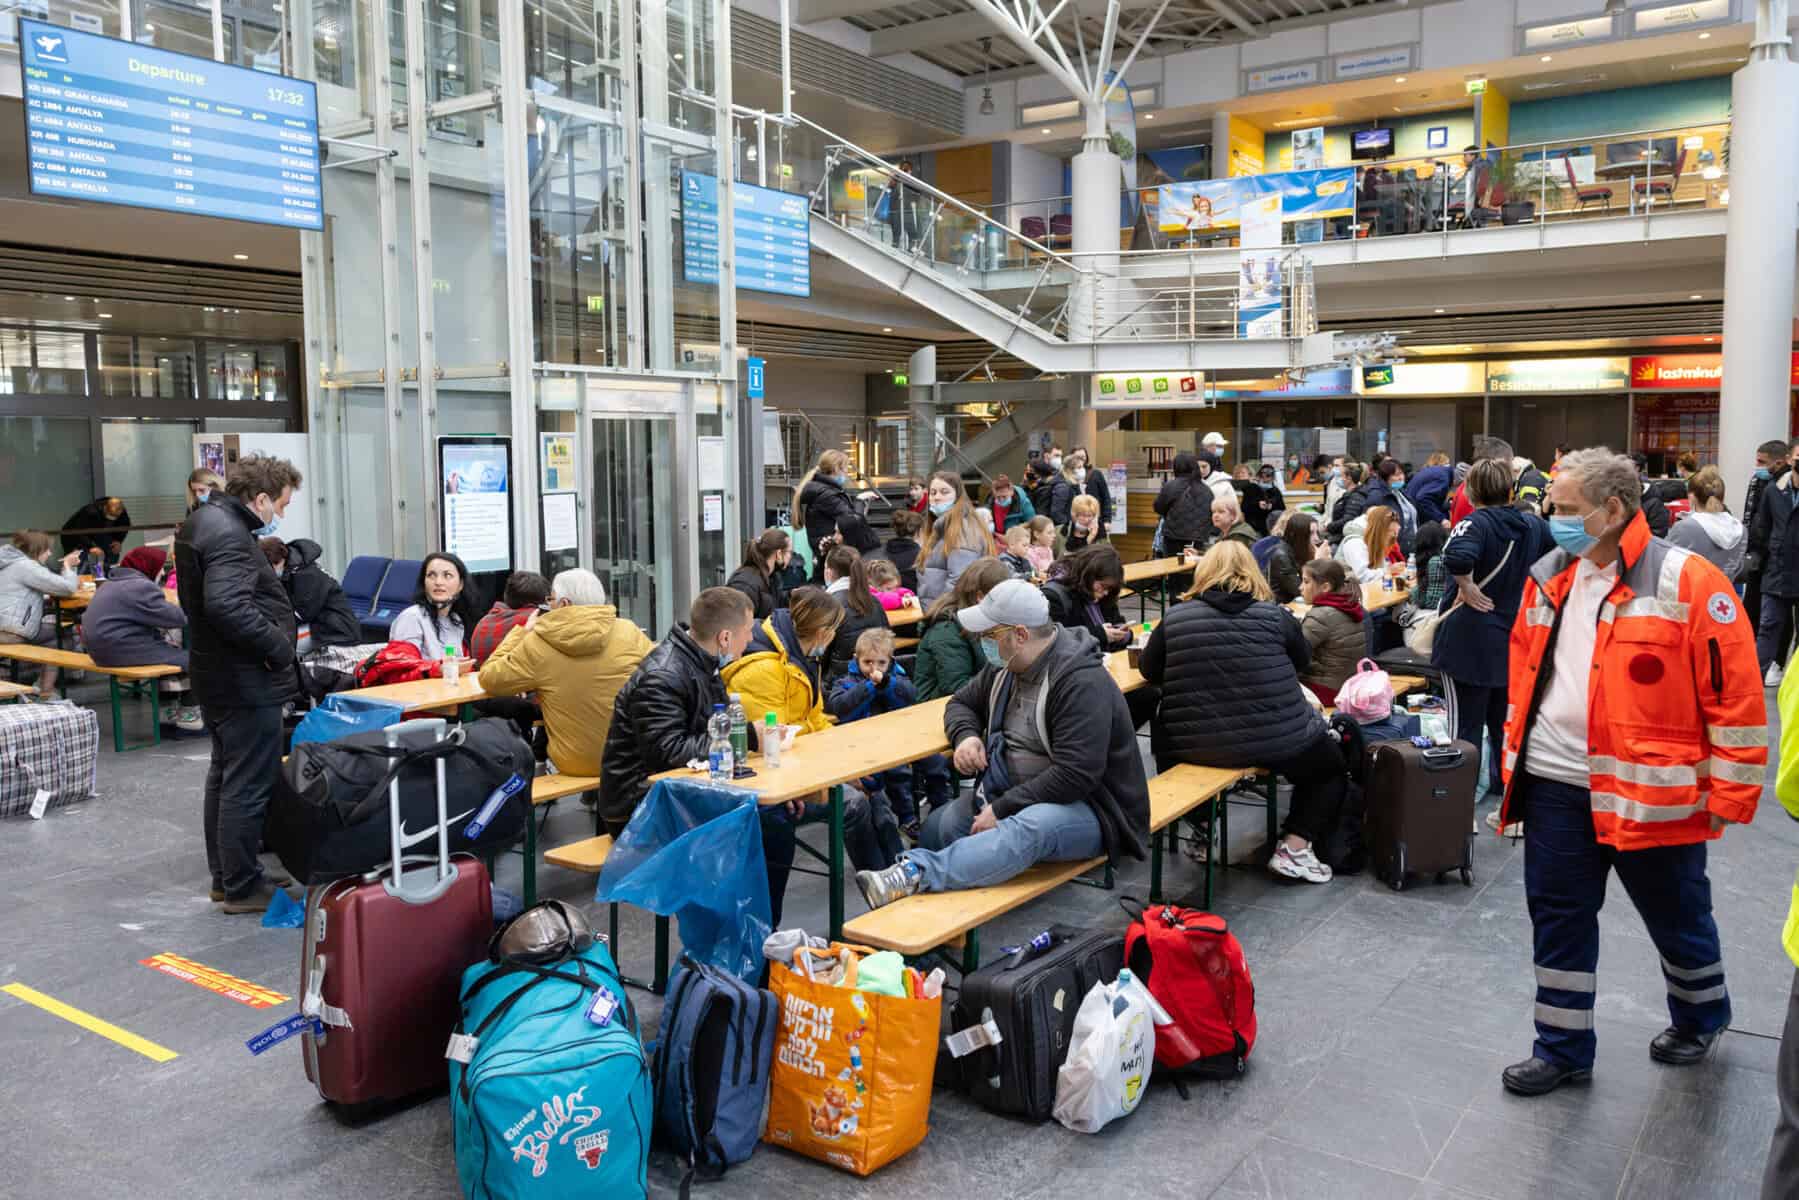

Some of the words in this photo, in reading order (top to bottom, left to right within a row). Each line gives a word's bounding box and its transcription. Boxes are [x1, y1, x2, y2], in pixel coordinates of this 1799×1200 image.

[128, 58, 206, 86] Departure
[64, 89, 89, 102] GRAN
[267, 88, 304, 106] 17:32
[65, 106, 104, 119] ANTALYA
[66, 120, 104, 134] ANTALYA
[69, 151, 106, 164] ANTALYA
[70, 167, 108, 179] ANTALYA
[71, 181, 109, 194] ANTALYA
[511, 1085, 602, 1177] Bulls
